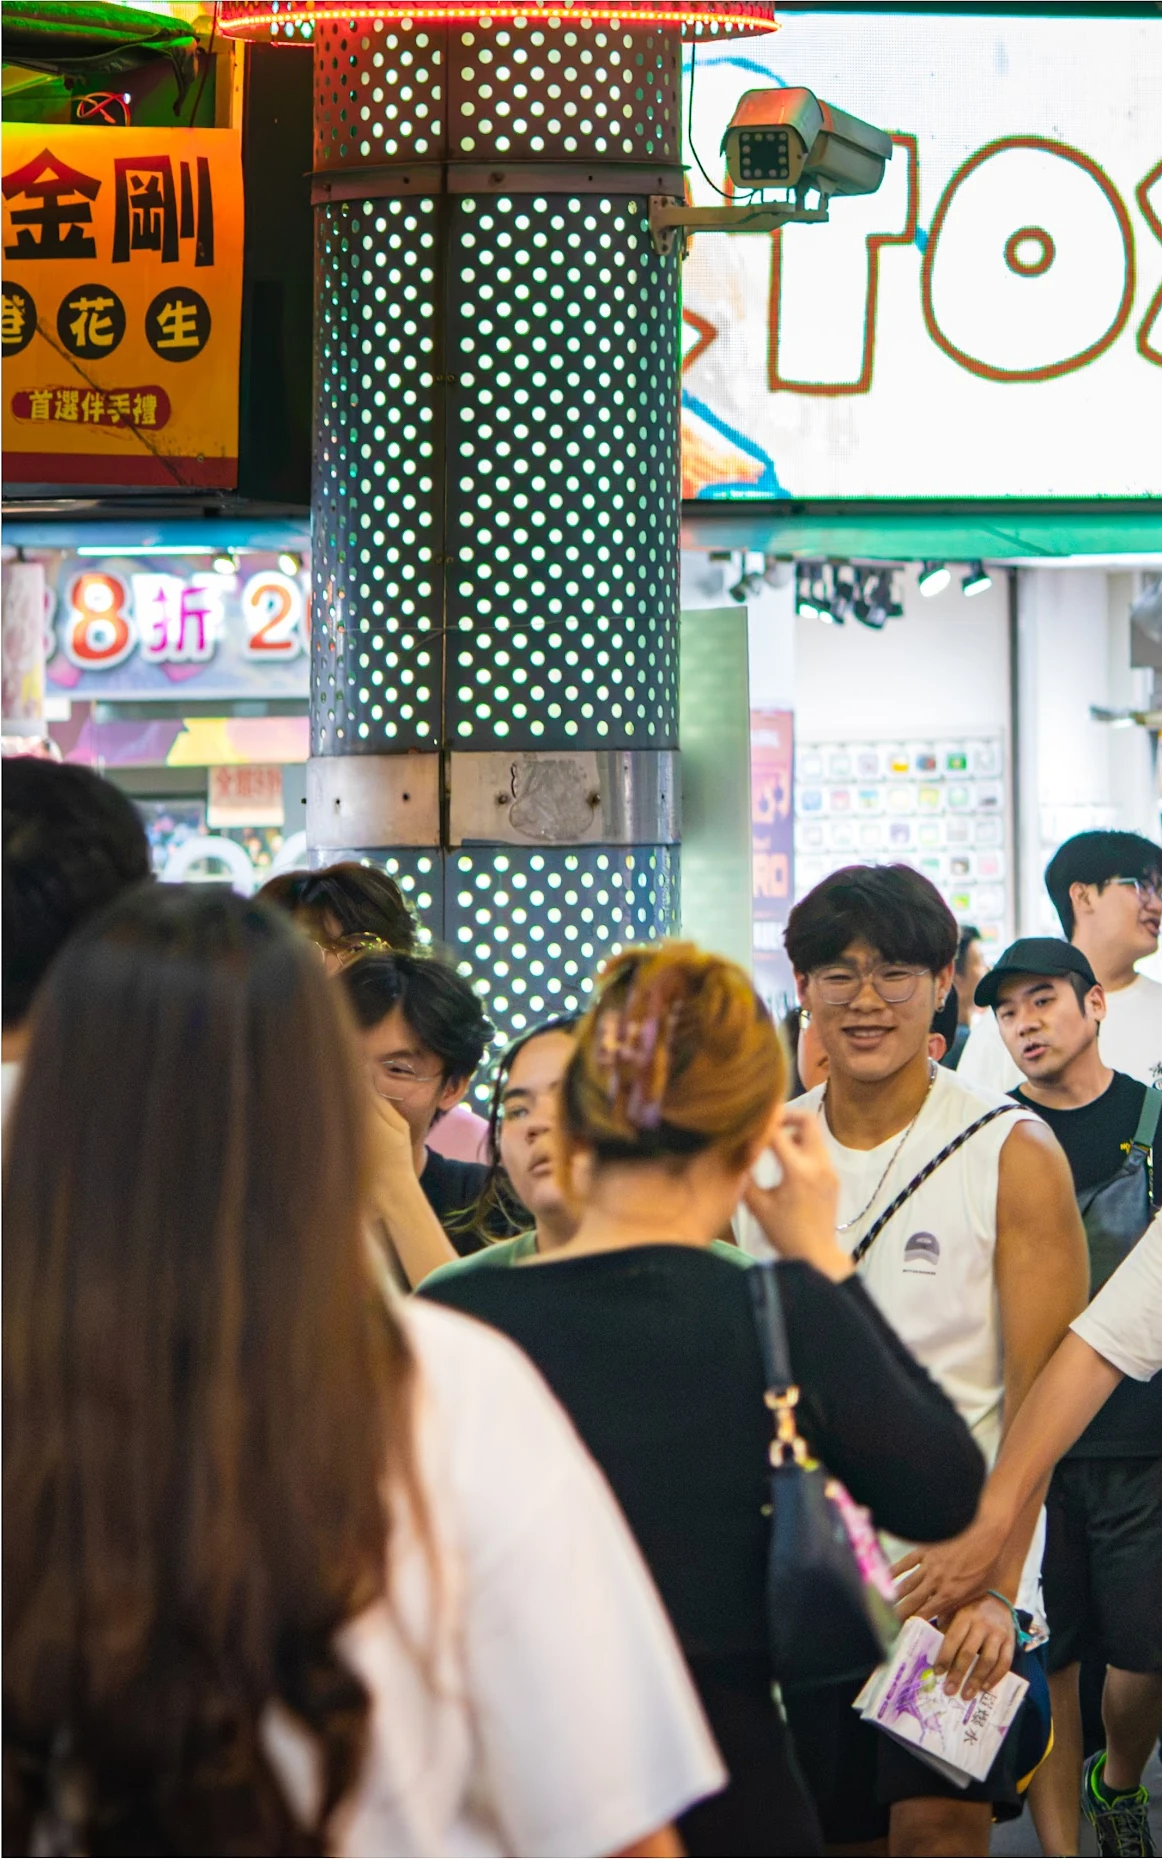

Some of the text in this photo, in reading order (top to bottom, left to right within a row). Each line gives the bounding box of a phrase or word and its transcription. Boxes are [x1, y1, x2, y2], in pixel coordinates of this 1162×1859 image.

[2, 147, 215, 268] 金剛
[28, 389, 158, 426] 首選伴手禮
